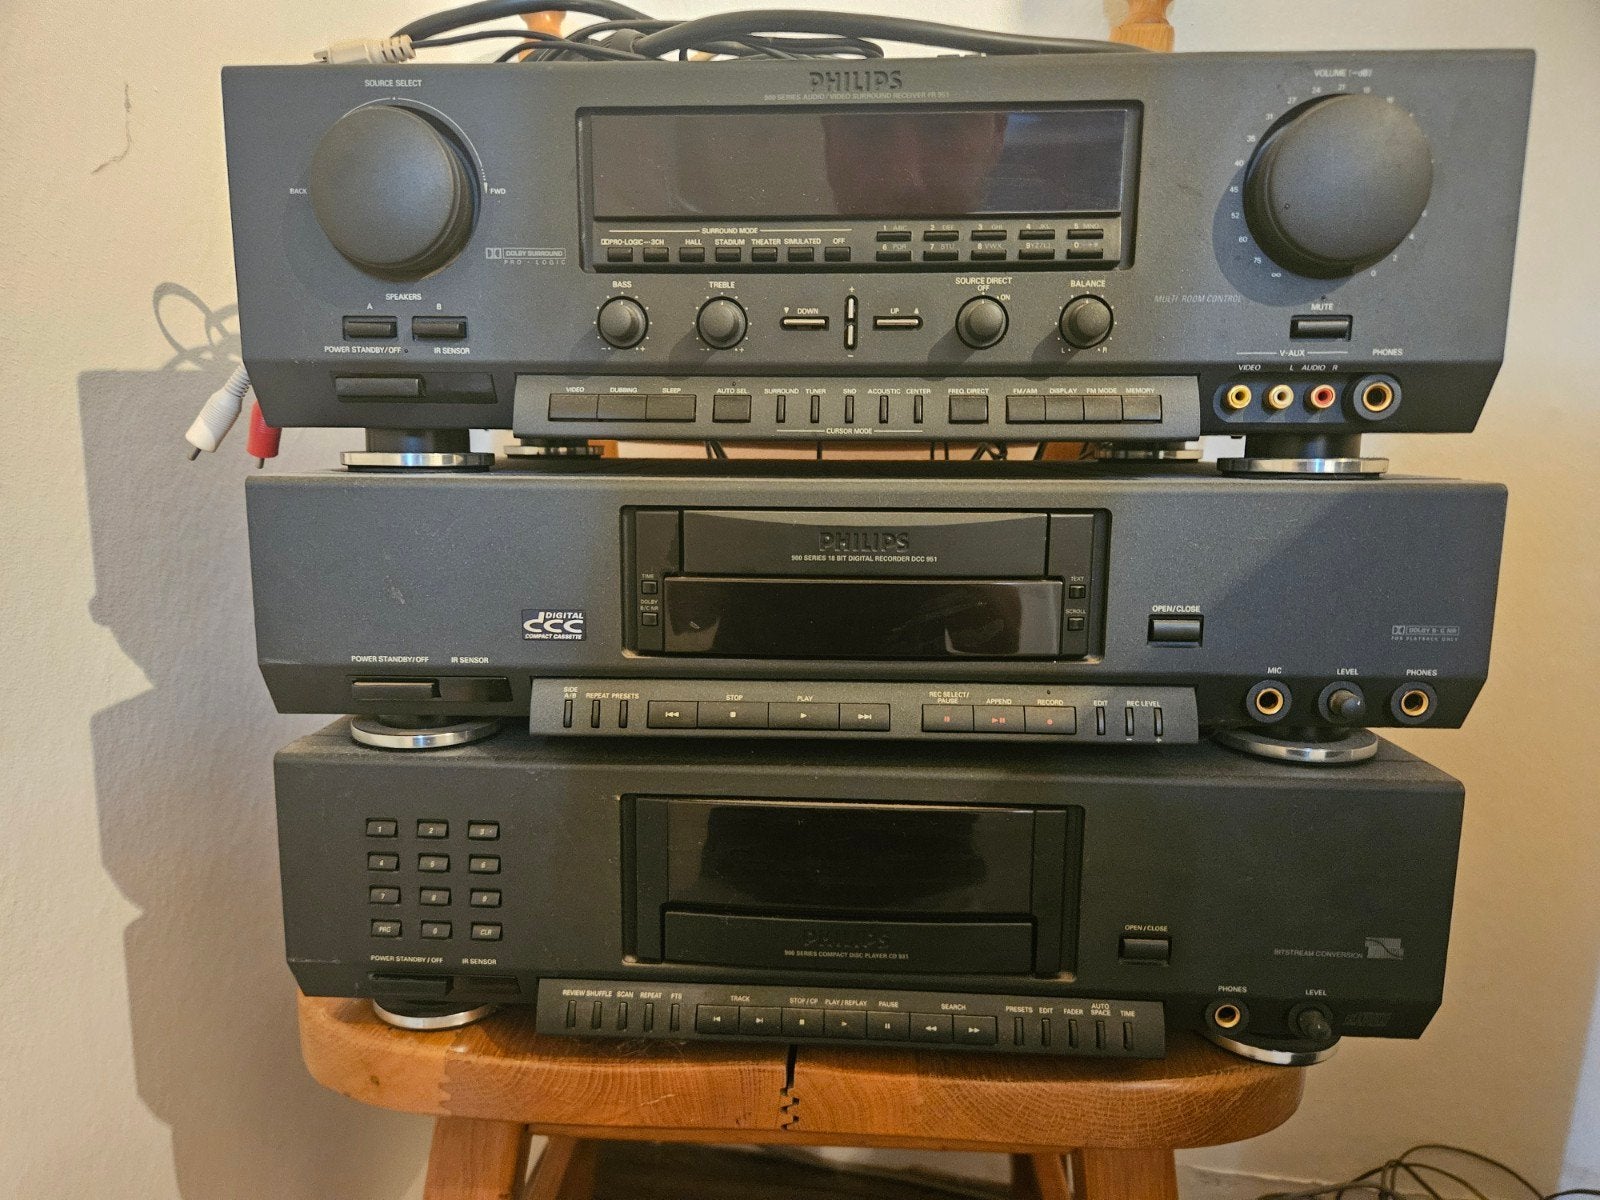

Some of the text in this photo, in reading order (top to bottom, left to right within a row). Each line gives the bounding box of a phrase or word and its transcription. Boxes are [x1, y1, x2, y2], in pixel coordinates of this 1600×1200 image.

[1314, 69, 1347, 77] VOLUME
[364, 79, 422, 87] SOURCE SELECT
[809, 71, 902, 92] PHILIPS
[701, 227, 738, 235] SURROUND
[612, 280, 633, 288] BASS
[955, 276, 1013, 285] SOURCE DIRECT
[1070, 280, 1106, 288] BALANCE
[708, 281, 736, 289] TREBLE
[977, 284, 990, 292] OFF
[385, 293, 422, 301] SPEAKERS
[1206, 295, 1241, 303] CONTROL
[797, 307, 819, 315] DOWN
[1311, 303, 1334, 311] MUTE
[443, 347, 470, 355] SENSOR
[1372, 348, 1403, 357] PHONES
[826, 427, 873, 435] CURSOR MODE
[819, 531, 909, 552] PHILIPS
[1152, 605, 1201, 613] OPEN/CLOSE
[351, 655, 378, 663] POWER
[1267, 667, 1282, 675] MIC
[1337, 668, 1359, 676] LEVEL
[1406, 669, 1438, 677] PHONES
[611, 692, 640, 700] PRESETS
[370, 954, 394, 962] POWER
[562, 989, 585, 997] REVIEW
[1218, 985, 1248, 993] PHONES
[586, 990, 613, 998] SHUFFLE
[640, 991, 662, 999] REPEAT
[671, 992, 683, 1000] FTS
[941, 1003, 967, 1011] SEARCH
